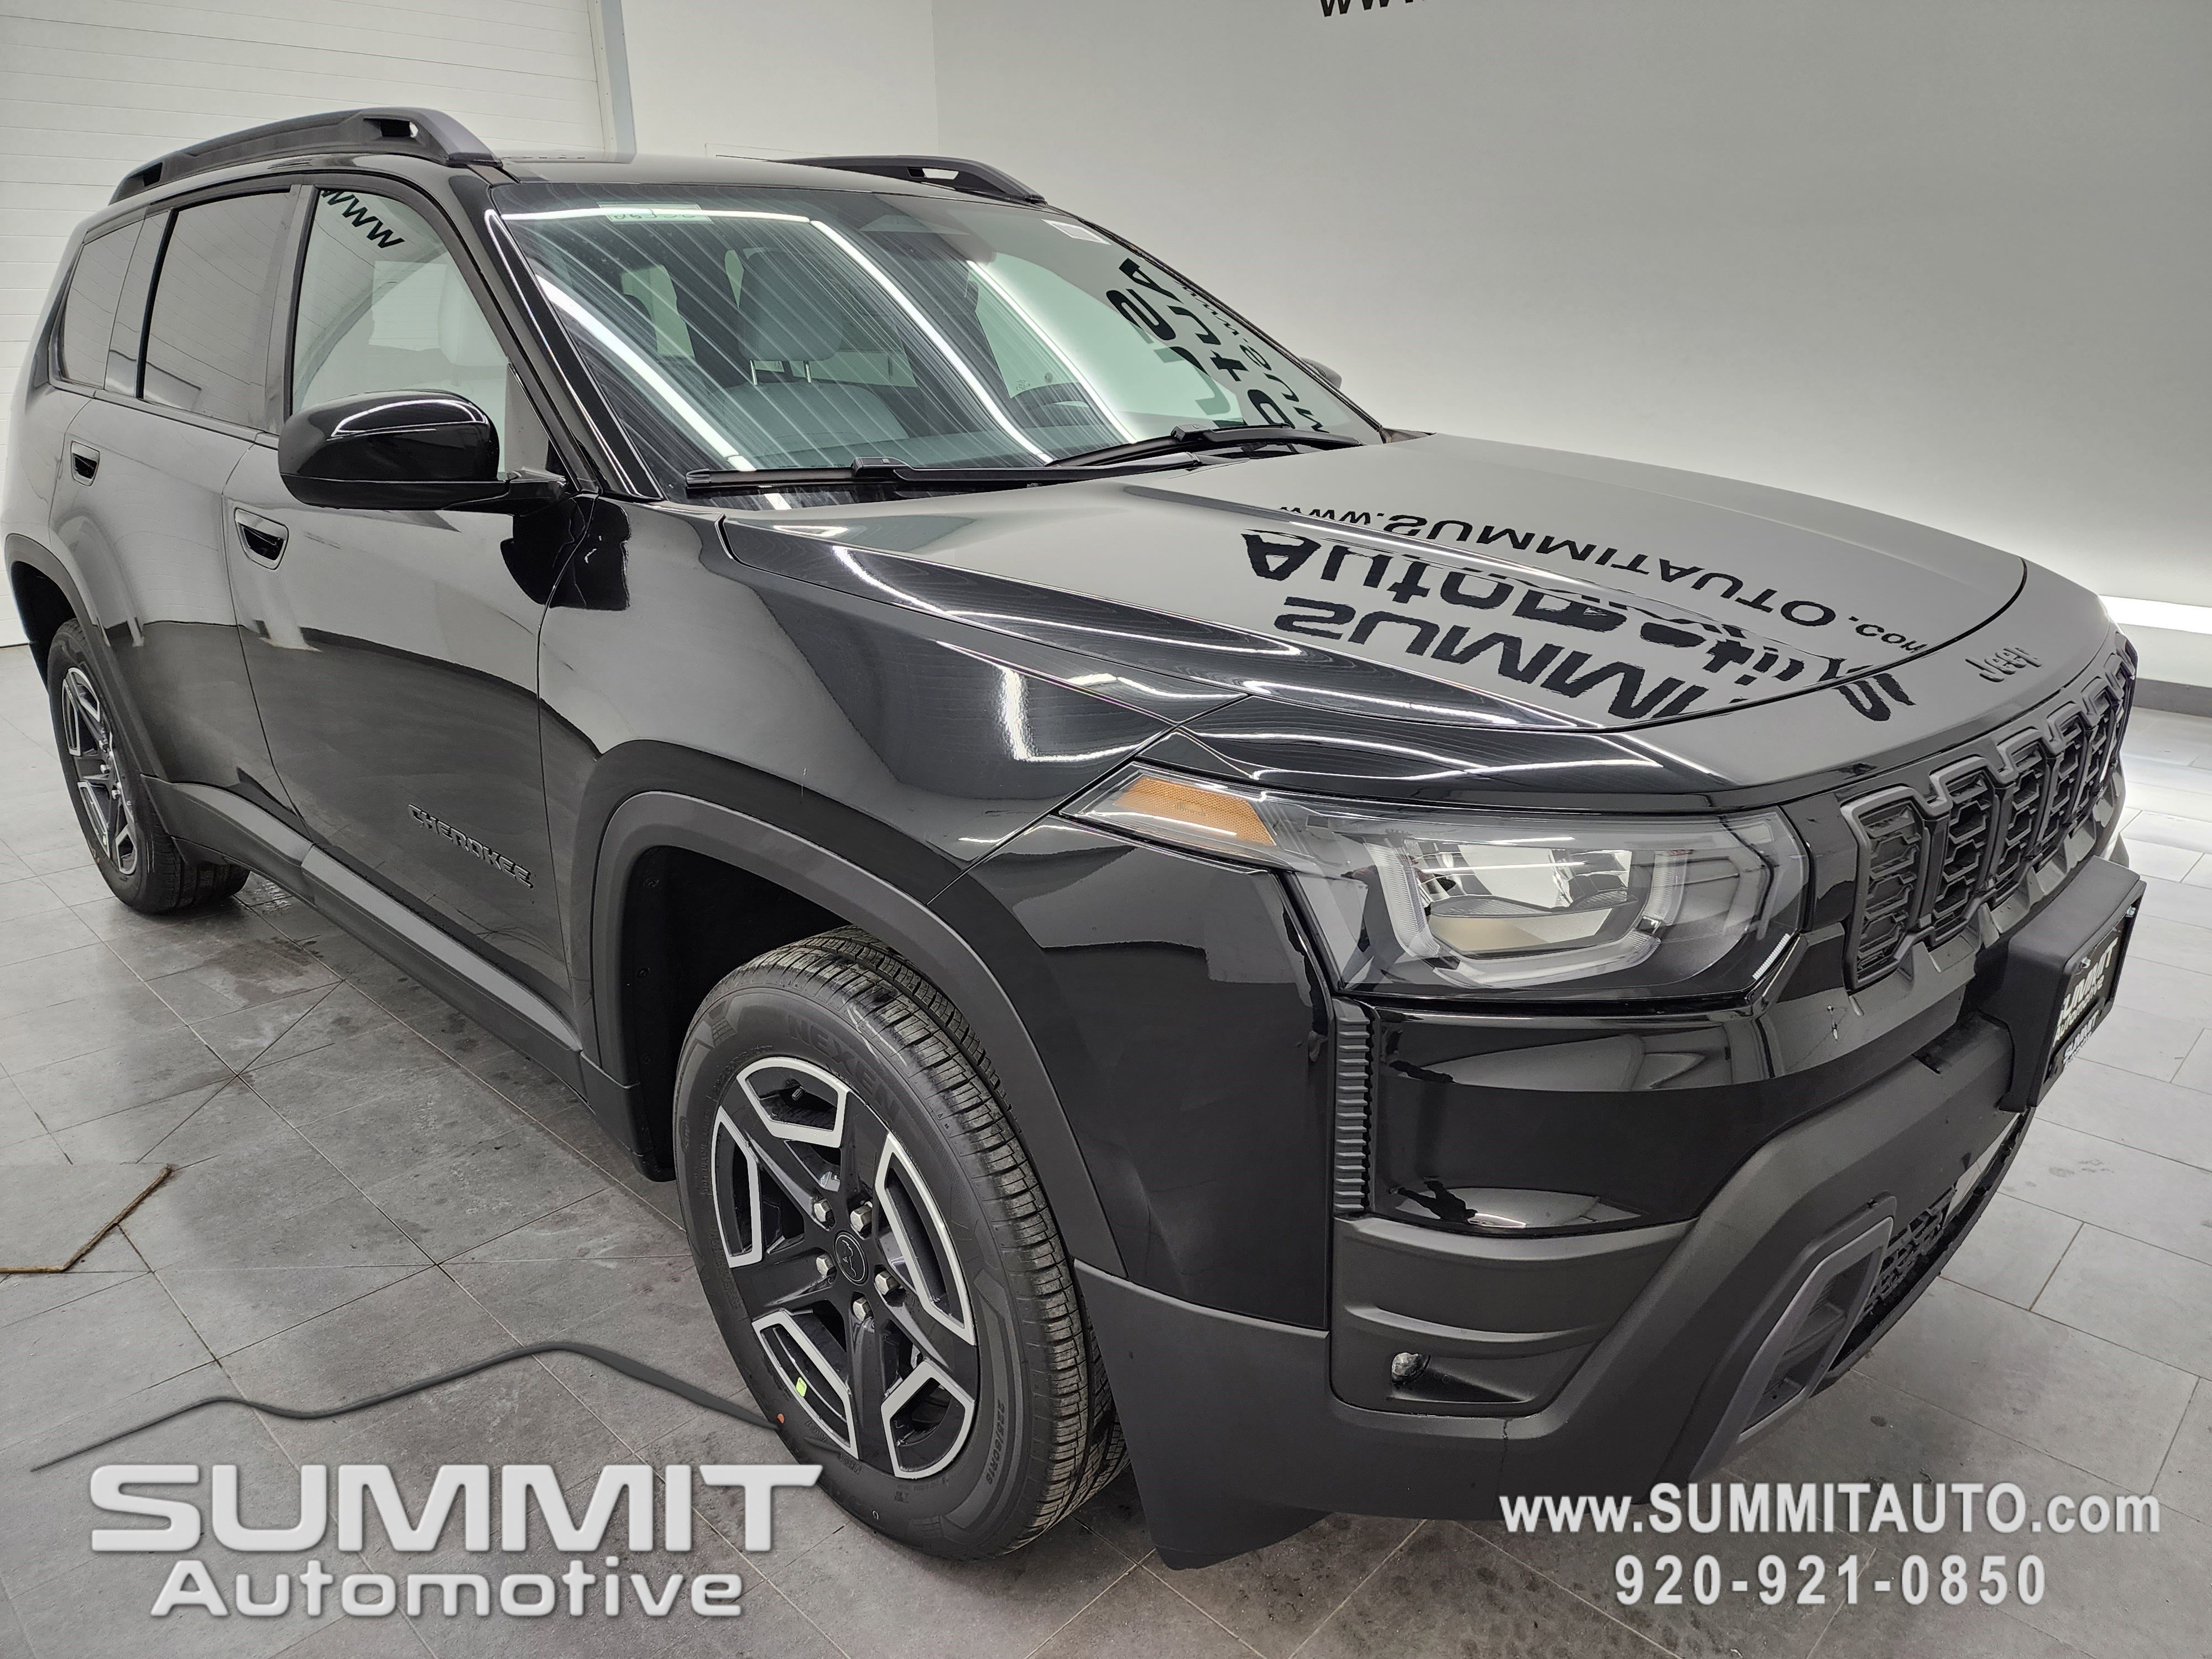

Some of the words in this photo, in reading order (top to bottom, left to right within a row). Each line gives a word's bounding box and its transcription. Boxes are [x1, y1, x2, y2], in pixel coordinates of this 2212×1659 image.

[1965, 646, 2043, 683] Jeep
[408, 802, 534, 889] CHEROKEE
[789, 1013, 902, 1125] NEXEN
